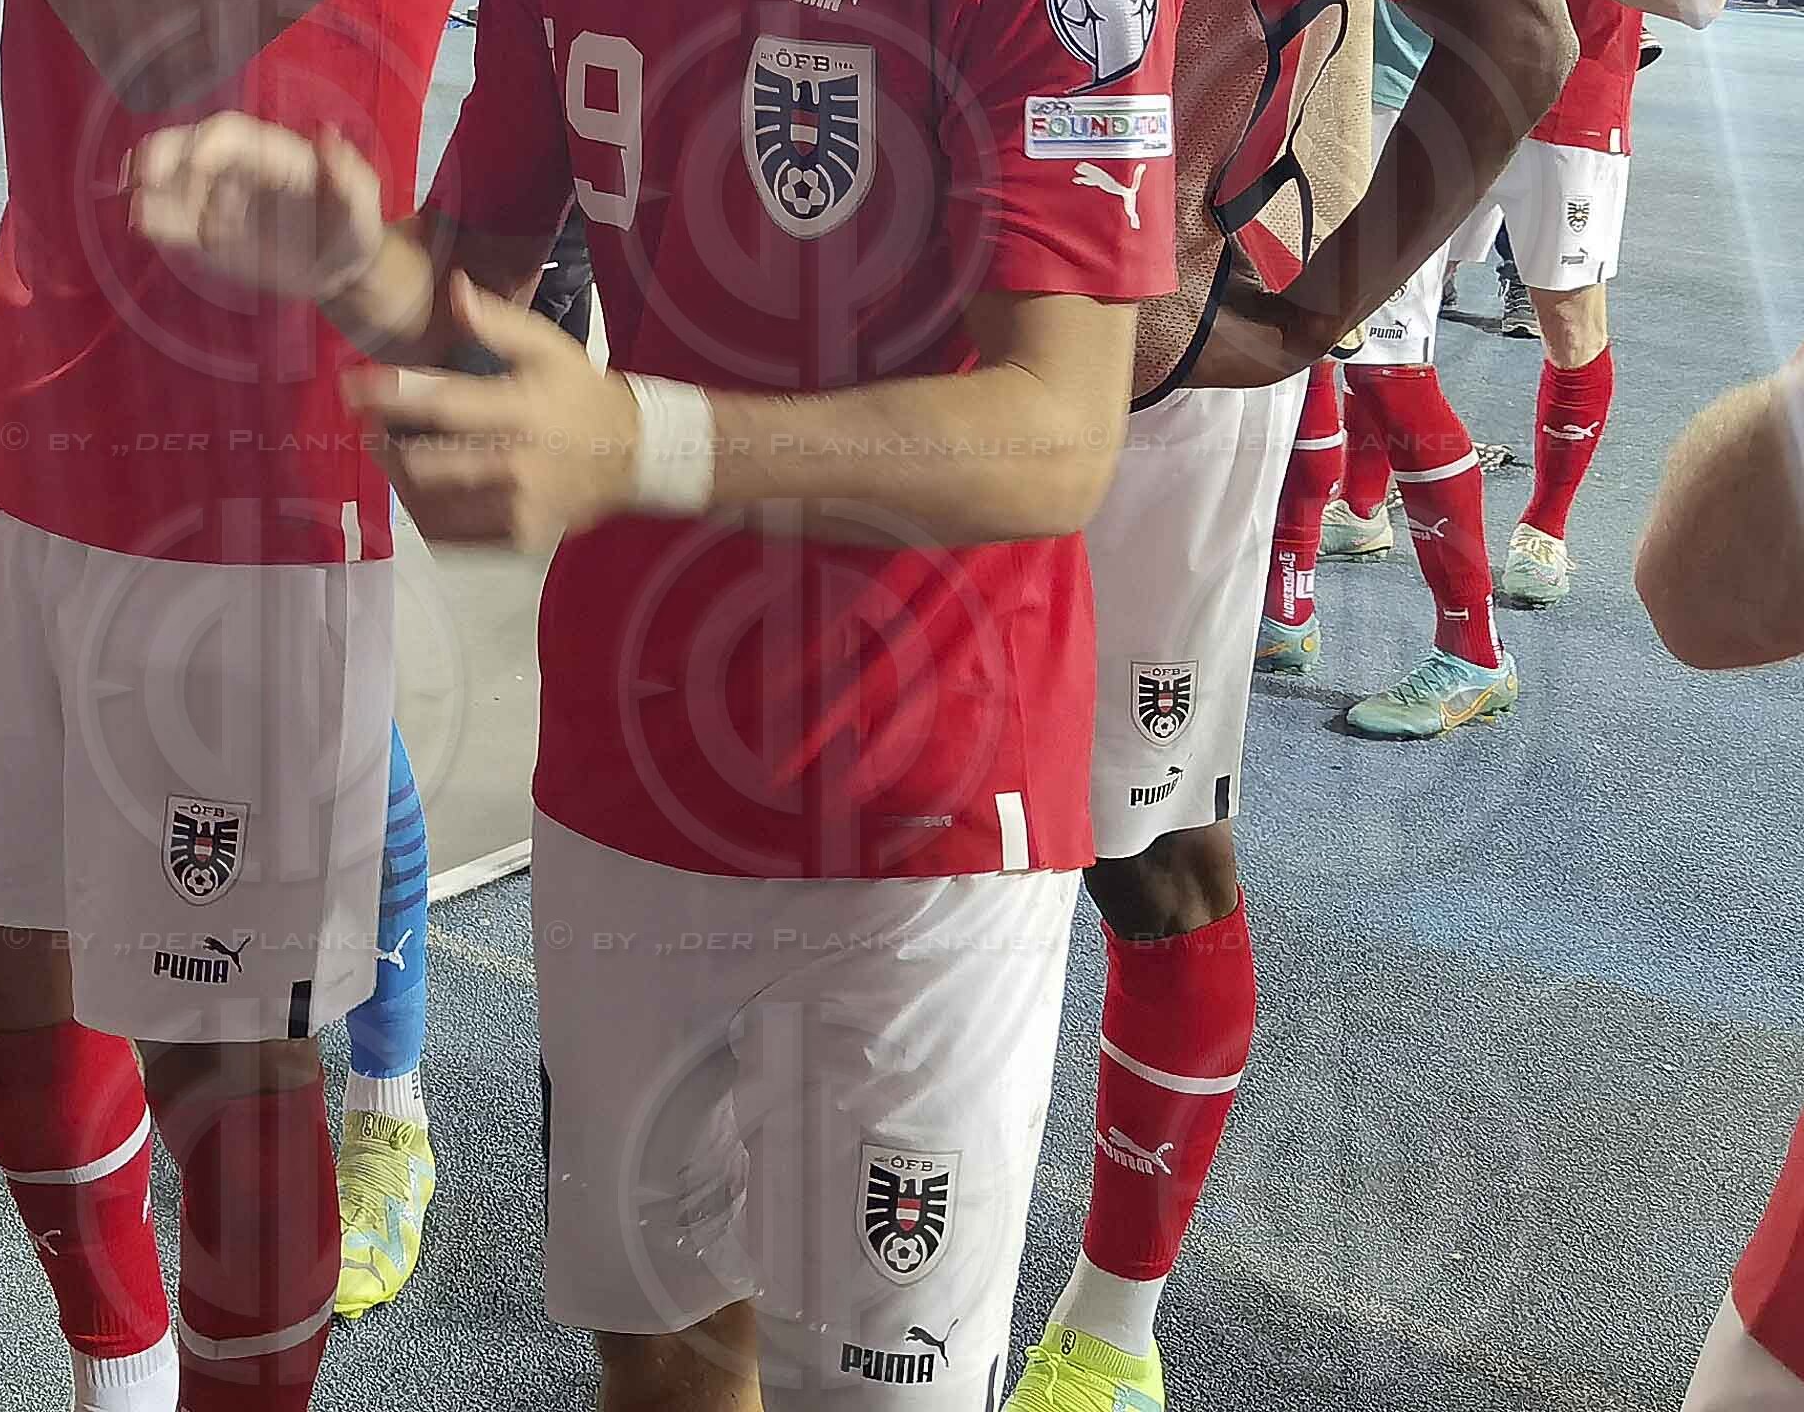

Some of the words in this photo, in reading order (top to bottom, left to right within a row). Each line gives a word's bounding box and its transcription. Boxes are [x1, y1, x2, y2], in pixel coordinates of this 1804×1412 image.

[776, 48, 831, 72] ÖFB
[1369, 326, 1403, 340] PUMA
[153, 951, 229, 983] PUMA
[890, 1155, 933, 1172] ÖFB
[841, 1342, 936, 1384] PUMA
